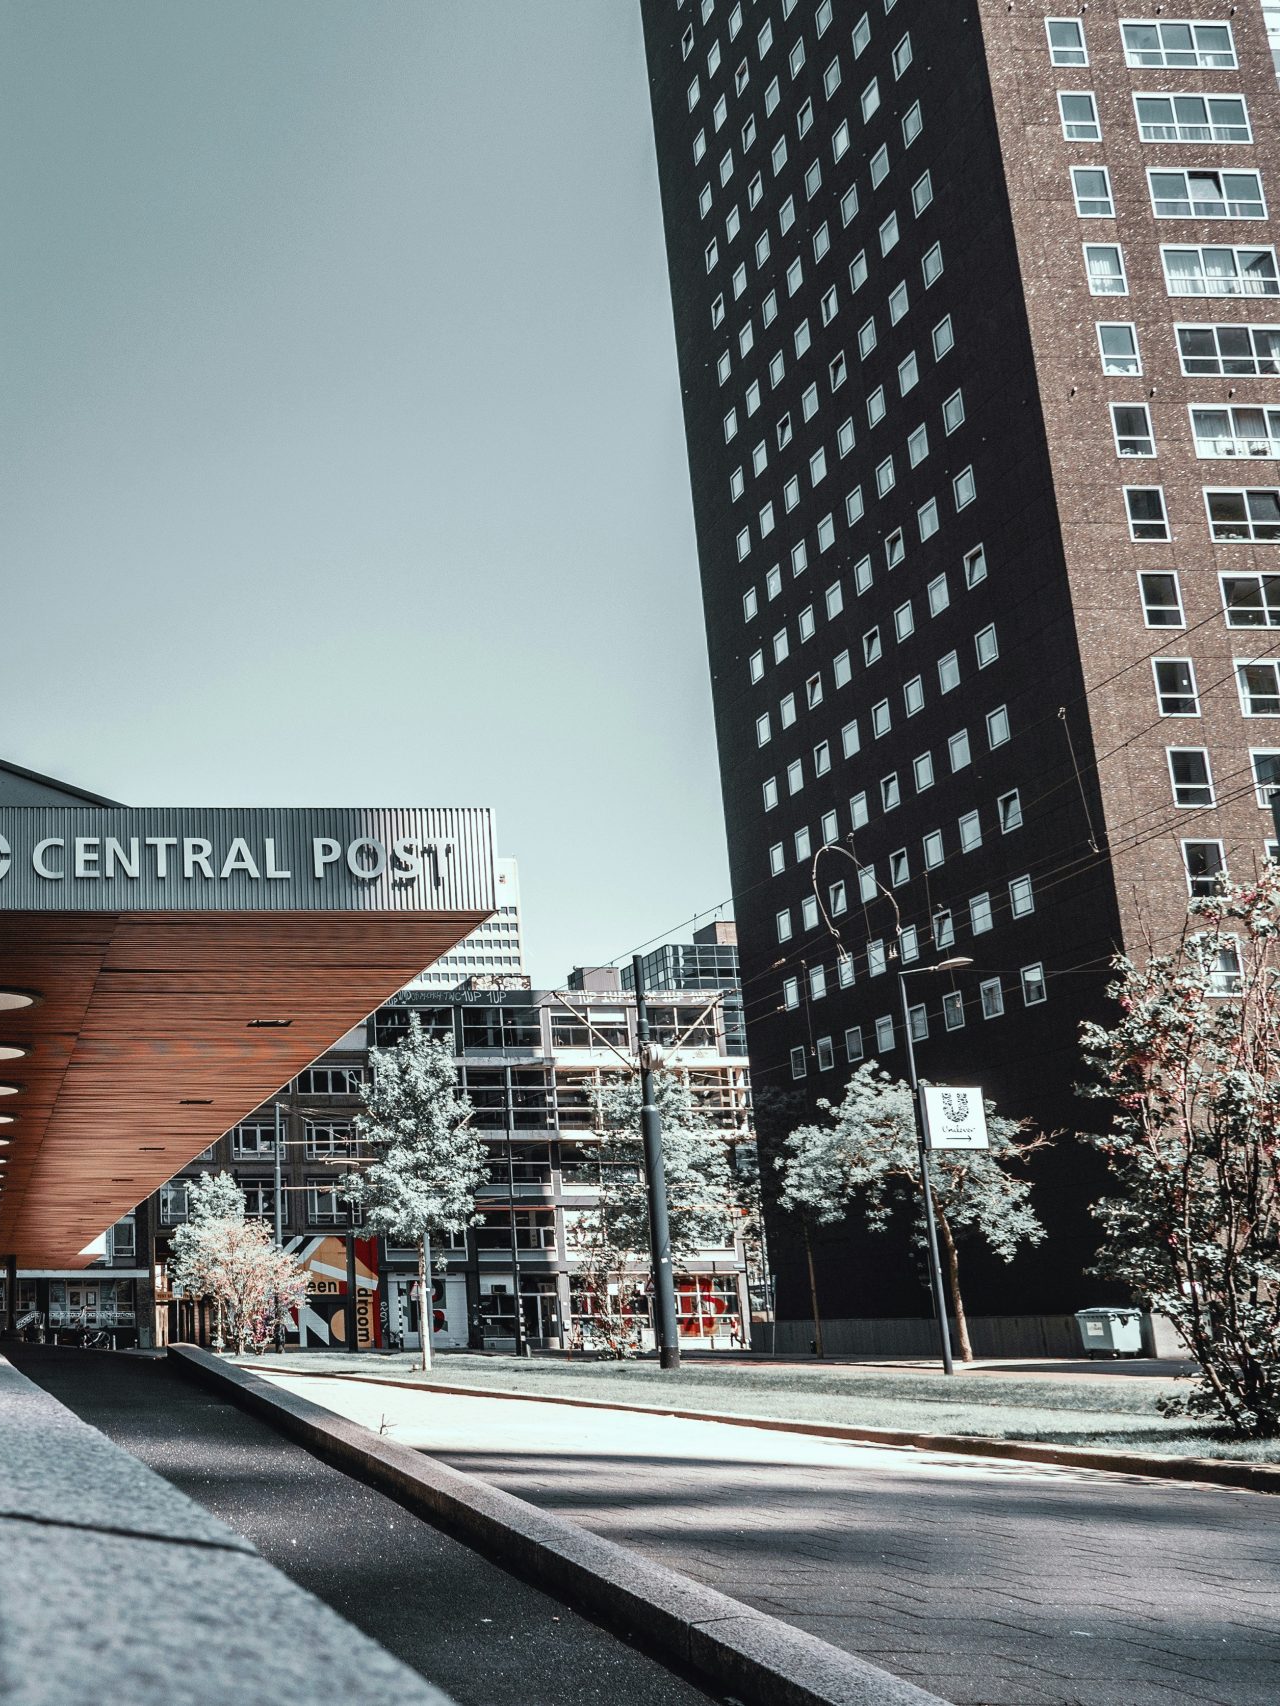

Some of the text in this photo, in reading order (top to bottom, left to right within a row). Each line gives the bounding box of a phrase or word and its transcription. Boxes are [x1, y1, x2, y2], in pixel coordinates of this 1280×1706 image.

[31, 836, 456, 880] CENTRAL POST
[461, 990, 482, 1002] 1UP
[486, 991, 507, 1004] 1UP
[357, 1287, 373, 1343] droom
